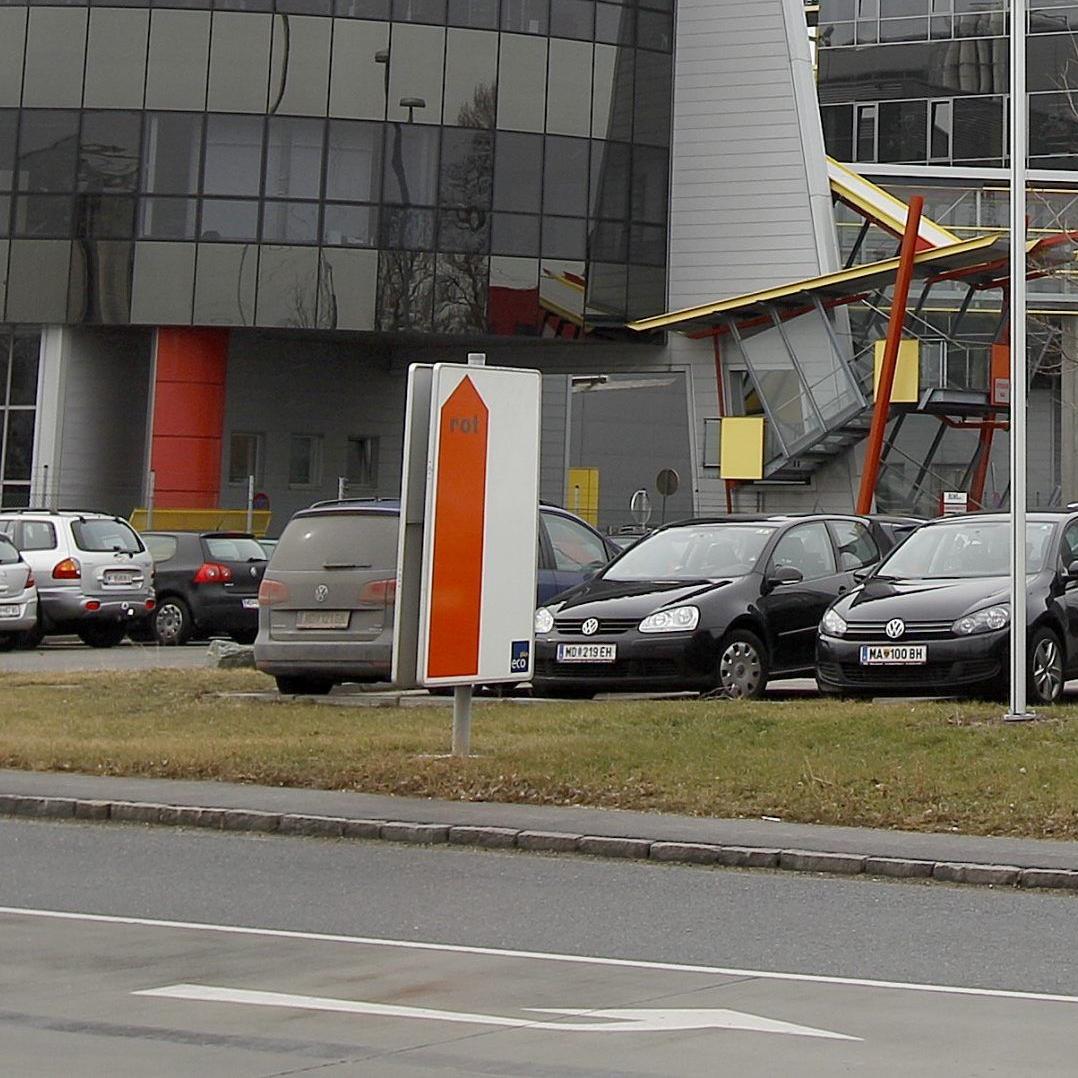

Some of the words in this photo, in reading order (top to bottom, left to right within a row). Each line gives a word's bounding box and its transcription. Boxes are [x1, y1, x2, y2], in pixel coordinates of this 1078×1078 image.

[450, 416, 479, 433] rot
[584, 647, 598, 657] 219
[601, 647, 612, 657] EH
[869, 649, 883, 659] MA
[891, 648, 907, 659] 100
[909, 648, 922, 659] BH
[511, 658, 526, 669] eco
